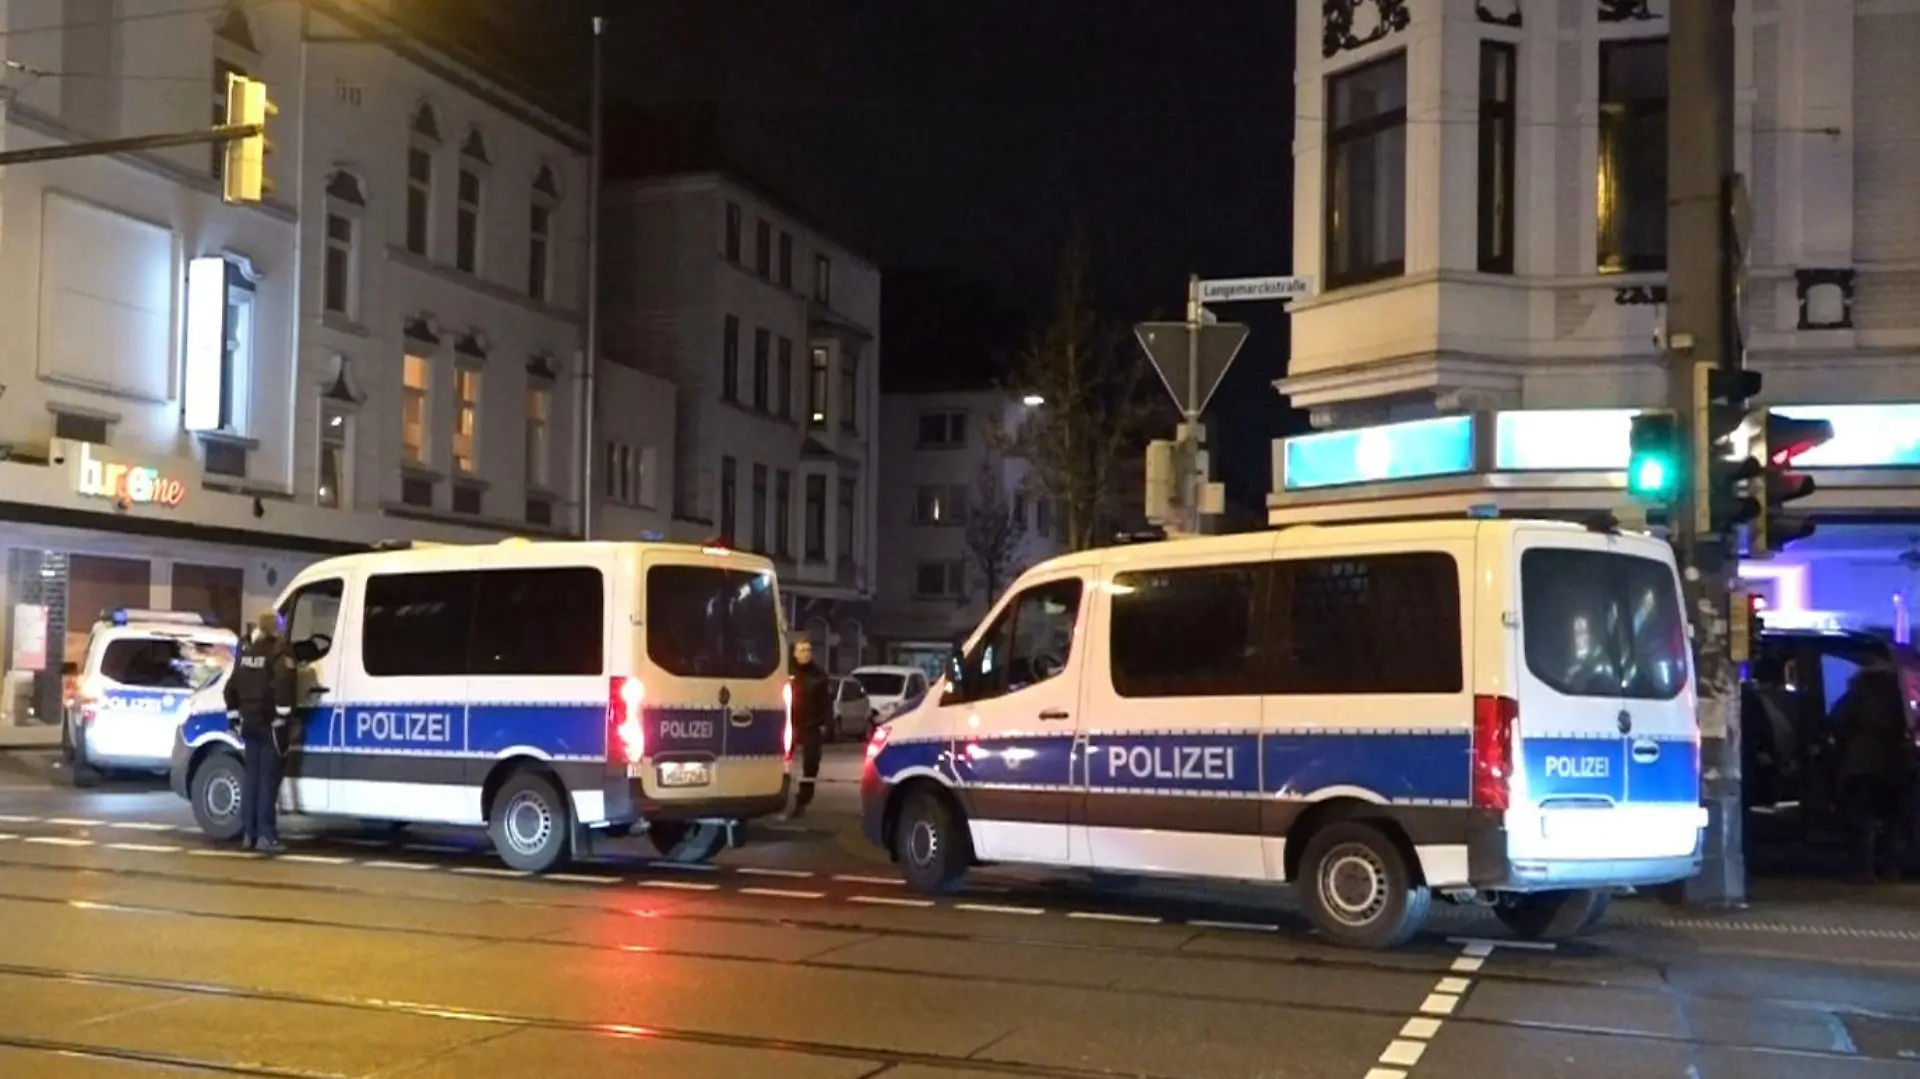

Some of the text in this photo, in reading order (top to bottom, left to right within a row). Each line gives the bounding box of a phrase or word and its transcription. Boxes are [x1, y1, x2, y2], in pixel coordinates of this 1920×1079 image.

[356, 711, 451, 742] POLIZEI
[659, 720, 713, 740] POLIZEI
[1108, 745, 1234, 780] POLIZEI
[1545, 755, 1610, 778] POLIZEI
